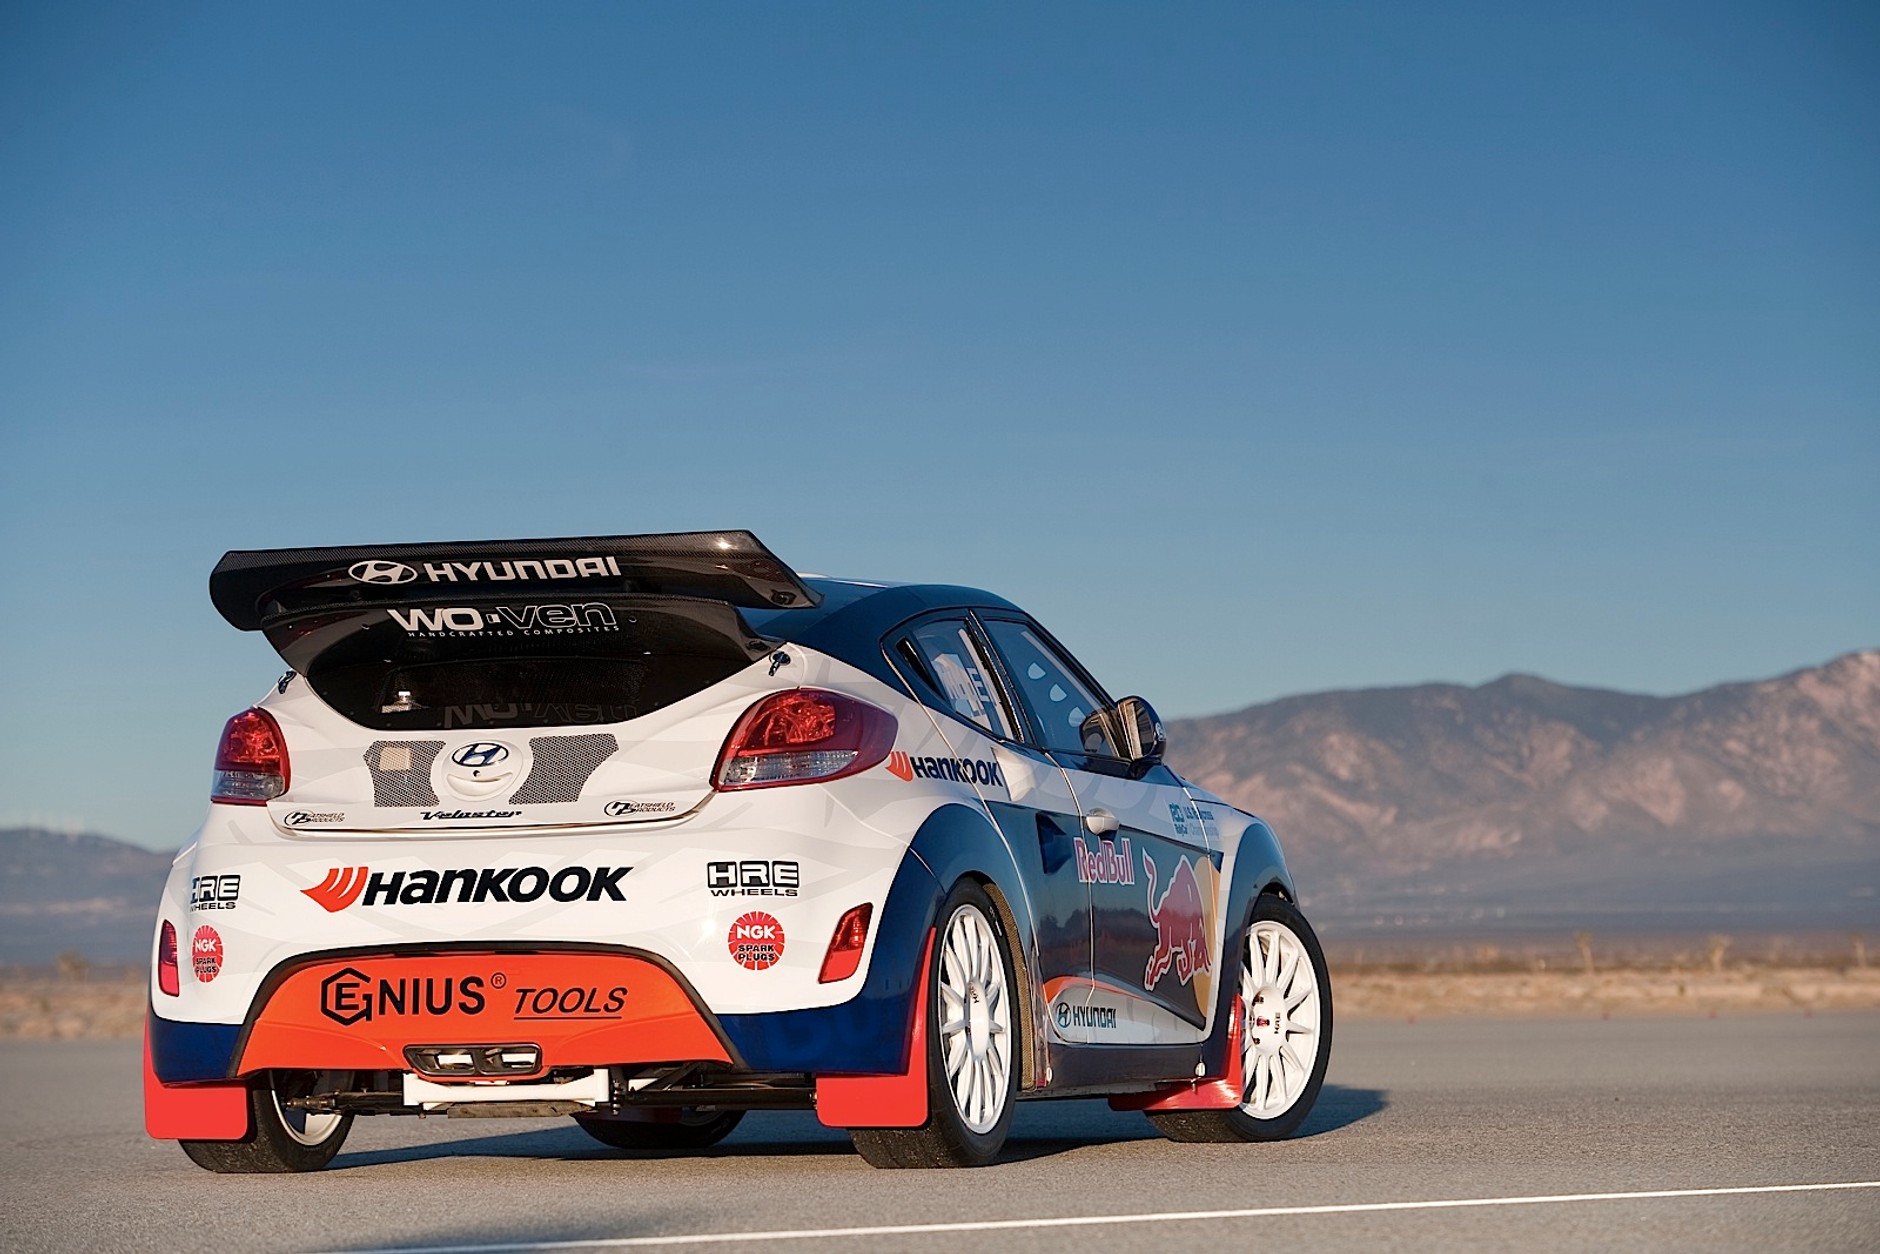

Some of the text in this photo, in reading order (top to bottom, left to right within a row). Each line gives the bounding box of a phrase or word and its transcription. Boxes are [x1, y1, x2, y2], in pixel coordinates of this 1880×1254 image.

[424, 556, 622, 582] HYUNDAI
[523, 625, 621, 635] COMPOSITES
[1074, 836, 1135, 885] Red Bull
[707, 860, 799, 888] HRE
[710, 888, 798, 897] WHEELS
[736, 924, 776, 940] NGK
[194, 938, 217, 952] NGK
[738, 944, 775, 952] SPARK
[738, 953, 775, 961] PLUGS
[513, 987, 628, 1014] TOOLS
[1073, 1005, 1117, 1028] HYUNDAI
